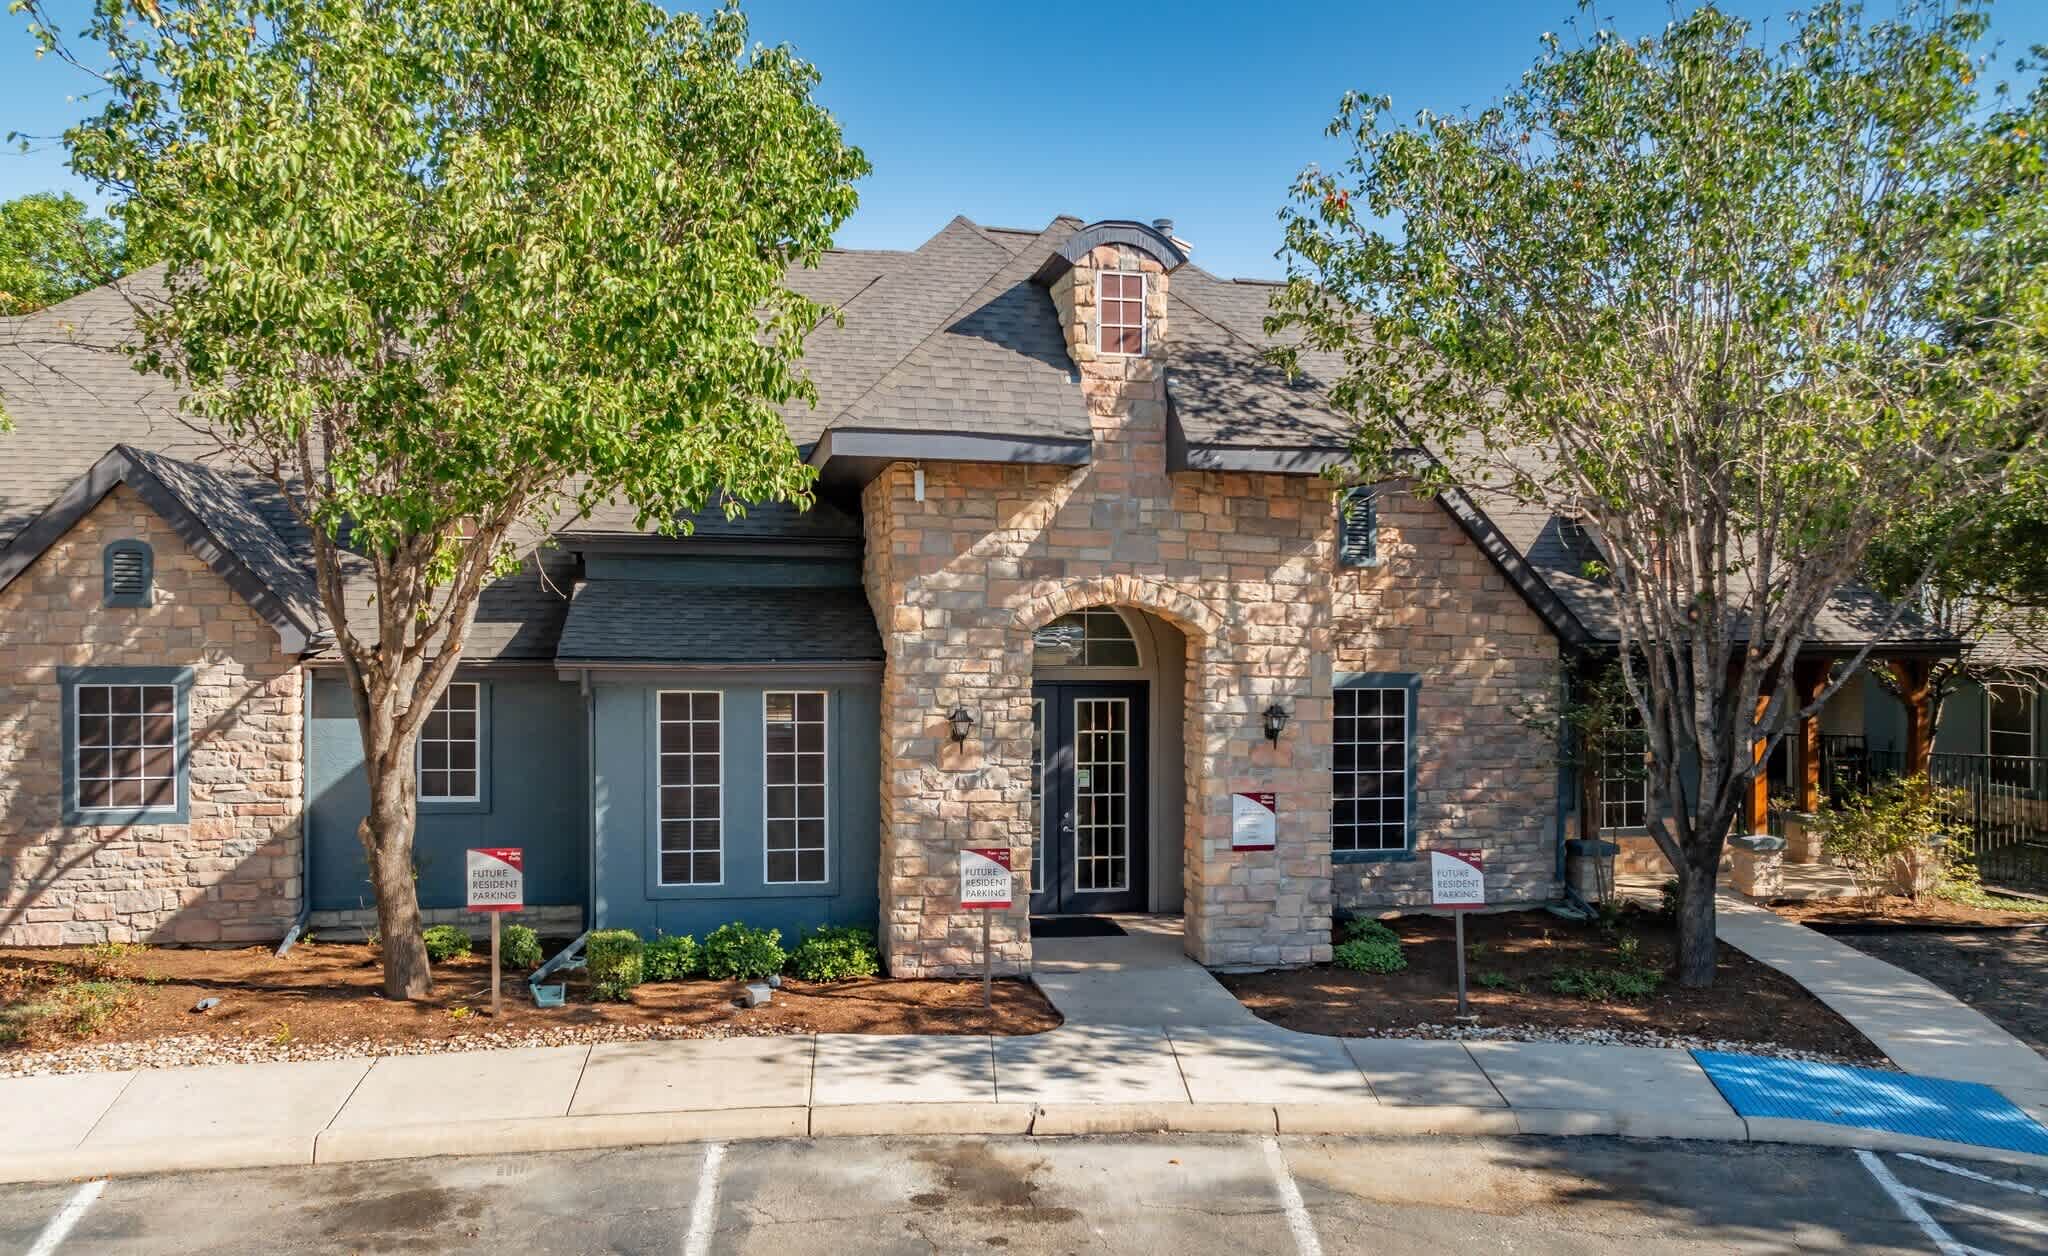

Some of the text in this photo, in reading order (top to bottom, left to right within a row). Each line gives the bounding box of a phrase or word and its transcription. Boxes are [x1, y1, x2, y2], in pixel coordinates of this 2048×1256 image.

[473, 869, 507, 878] FUTURE
[965, 868, 999, 877] FUTURE
[1437, 869, 1469, 878] FUTURE
[472, 880, 517, 889] RESIDENT
[966, 879, 1007, 887] RESIDENT
[1437, 880, 1479, 888] RESIDENT
[473, 891, 516, 900] PARKING
[966, 889, 1006, 897] PARKING
[1438, 889, 1479, 898] PARKING
